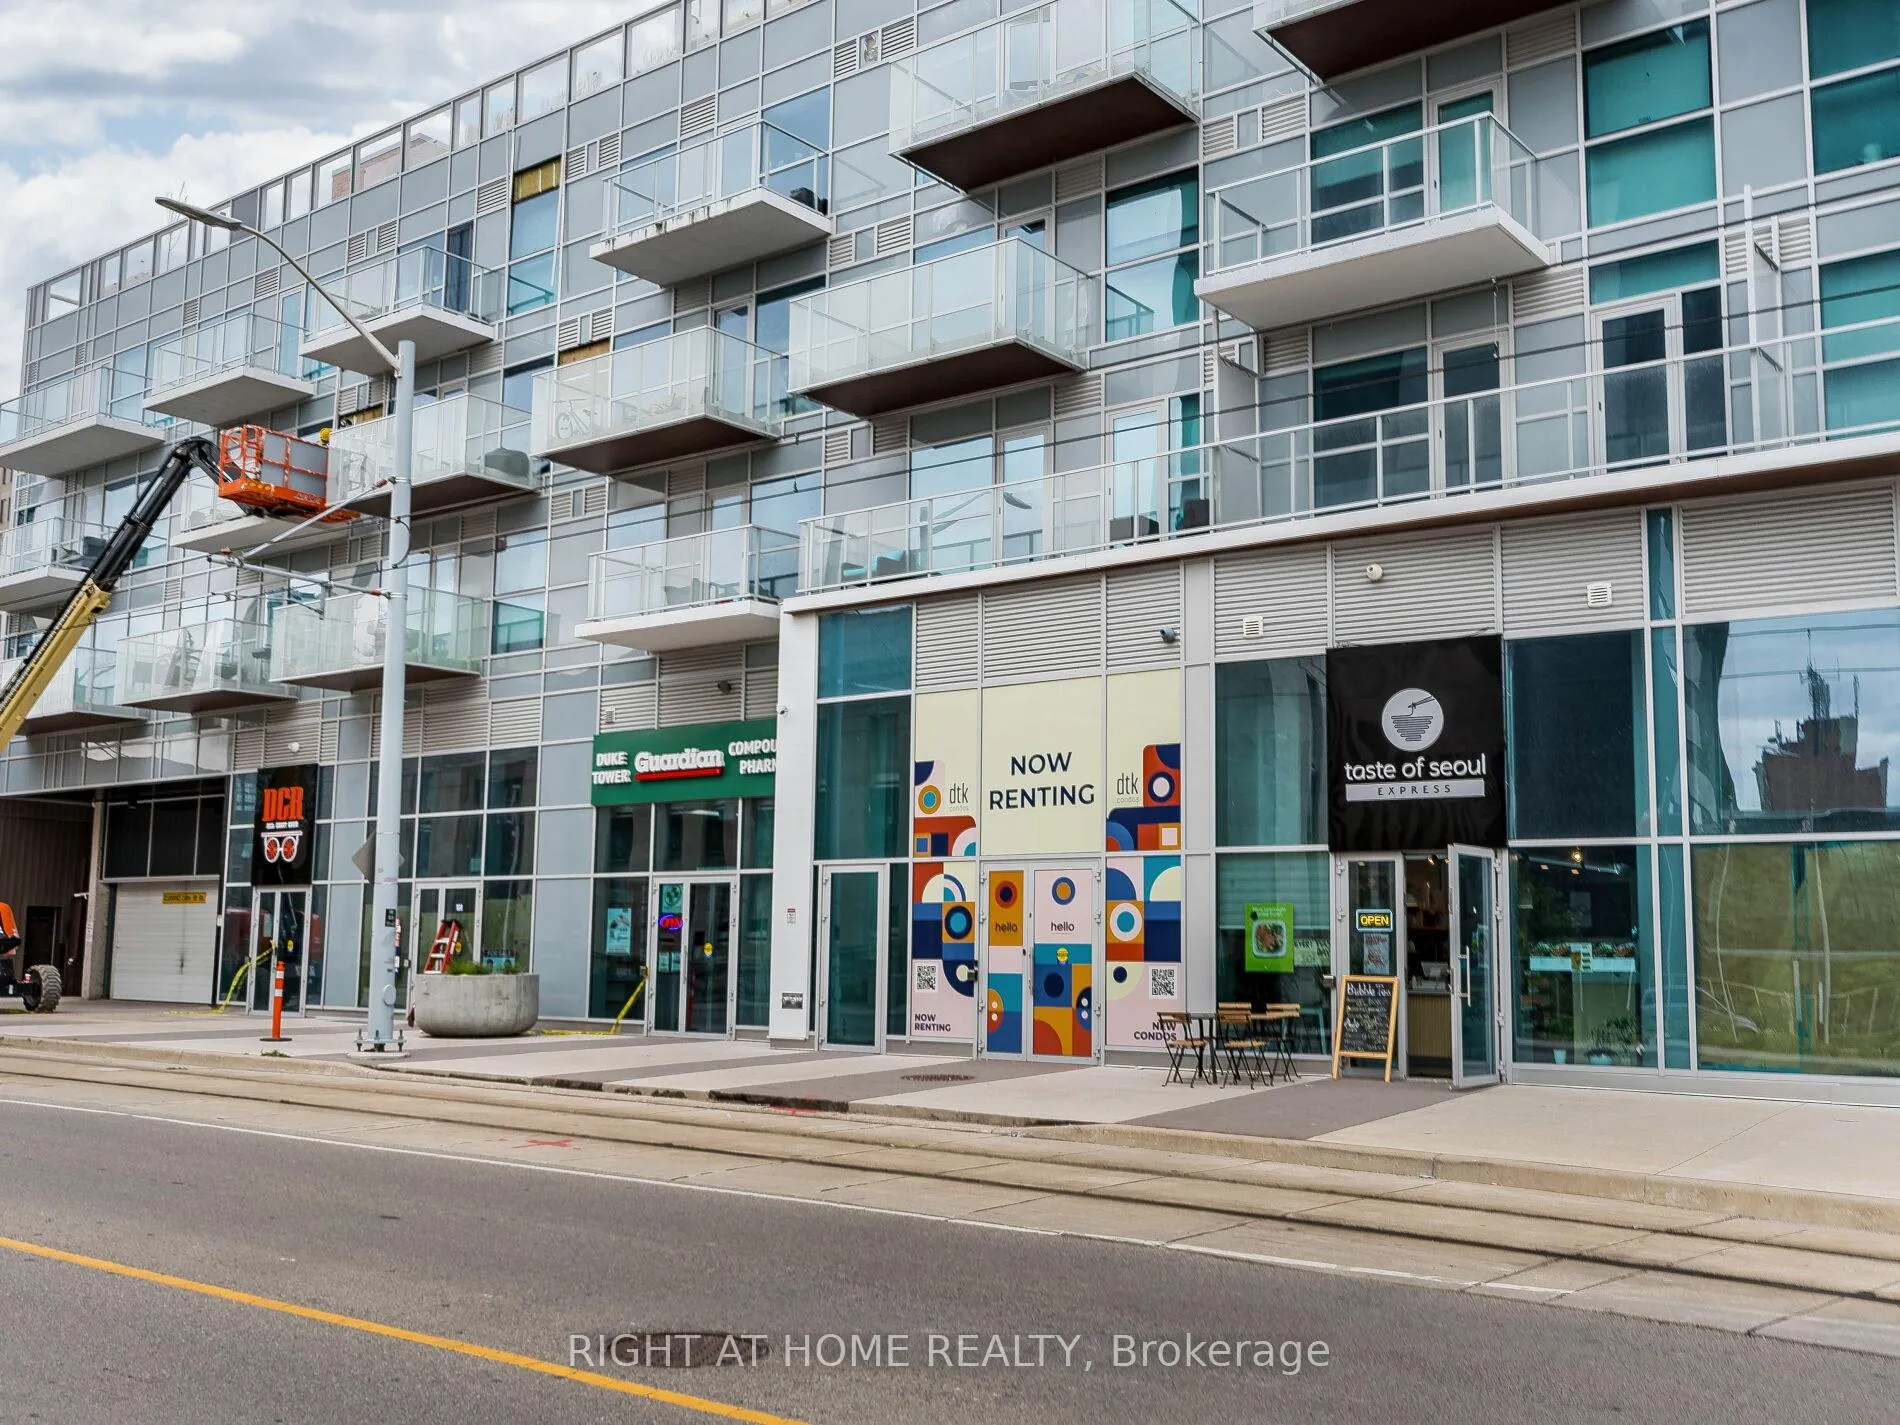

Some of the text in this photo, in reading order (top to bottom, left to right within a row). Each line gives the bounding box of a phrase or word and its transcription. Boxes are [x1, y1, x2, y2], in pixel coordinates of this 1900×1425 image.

[596, 751, 629, 767] DUKE
[634, 748, 725, 773] Guardian
[1010, 752, 1072, 776] NOW
[1344, 752, 1487, 781] taste of seoul
[592, 769, 632, 784] TOWER
[1117, 771, 1139, 796] dtk
[949, 782, 969, 804] dtk
[989, 784, 1095, 811] RENTING
[1378, 784, 1452, 797] EXPRESS
[262, 786, 304, 822] DCR
[995, 922, 1018, 933] hello
[1050, 921, 1075, 932] hello
[1360, 914, 1389, 927] OPEN
[914, 1013, 936, 1022] NOW
[914, 1022, 951, 1033] RENTING
[1133, 1030, 1178, 1042] CONDOS
